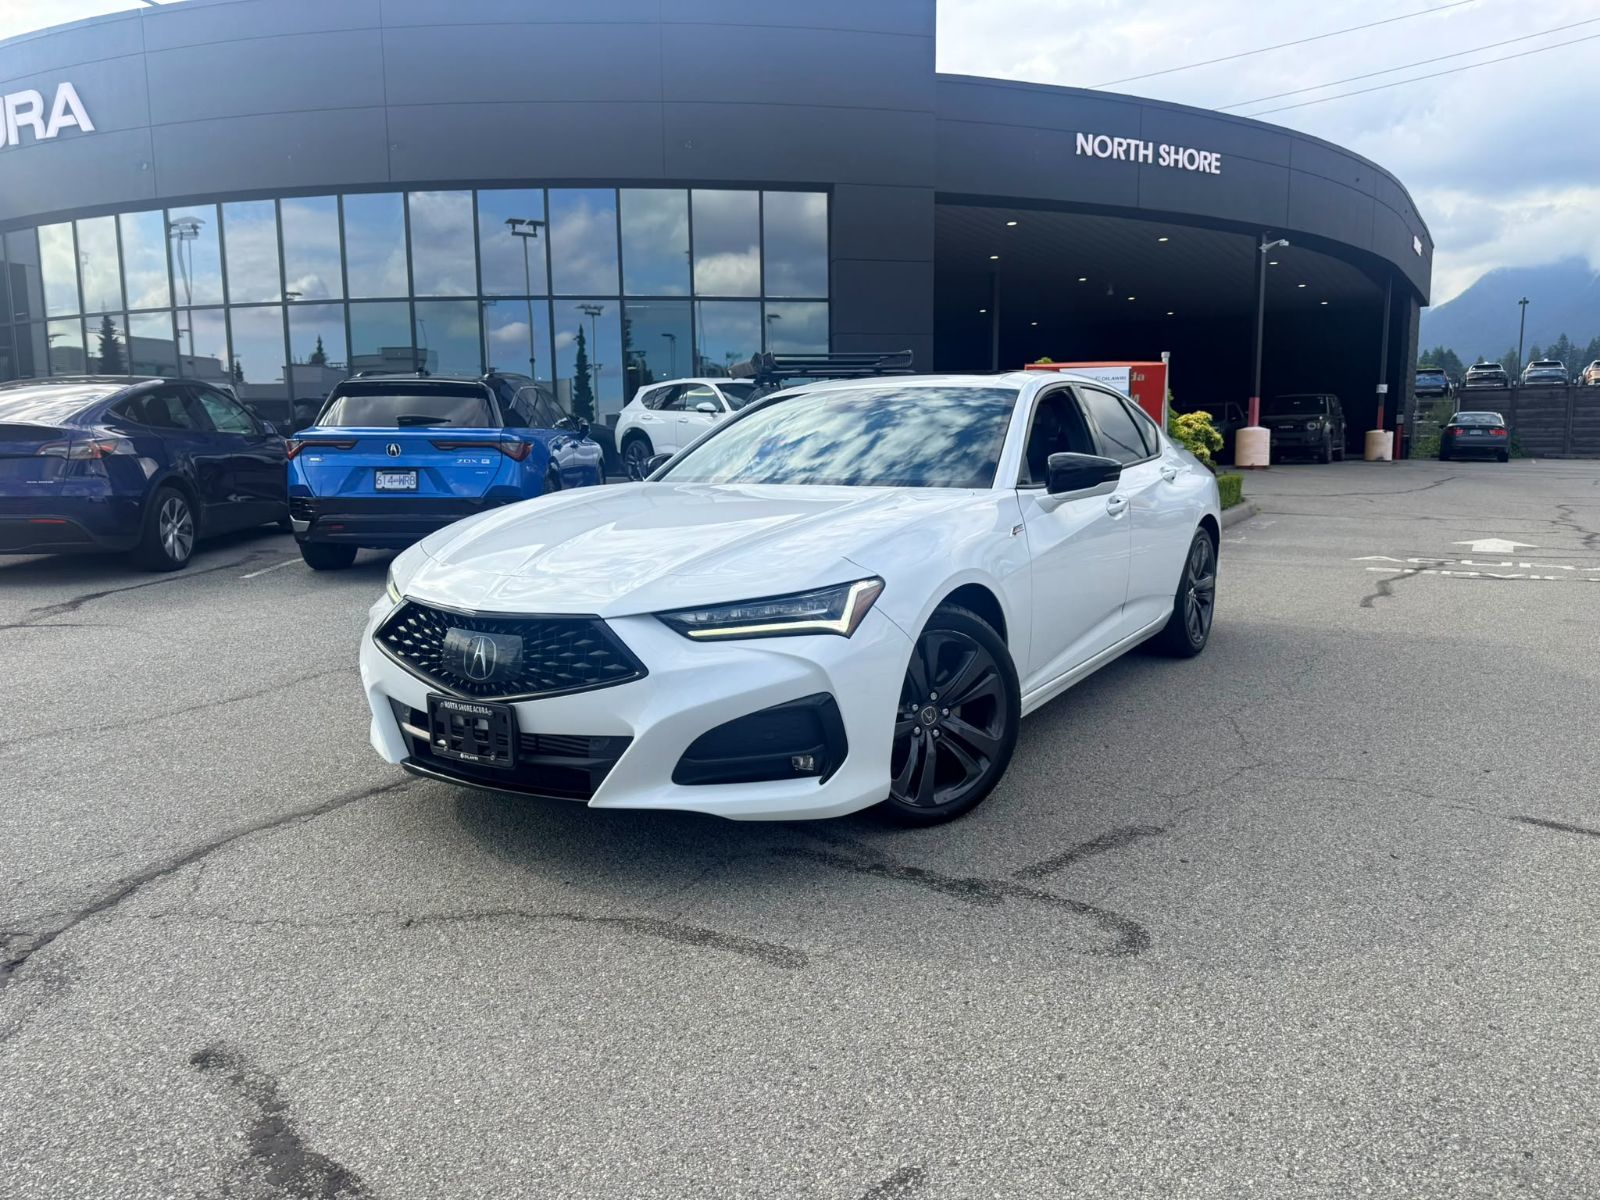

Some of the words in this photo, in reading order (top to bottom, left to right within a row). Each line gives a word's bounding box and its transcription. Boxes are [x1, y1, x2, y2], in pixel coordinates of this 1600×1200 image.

[1076, 132, 1154, 164] NORTH
[1158, 143, 1222, 175] SHORE
[444, 700, 458, 710] NORTH
[458, 703, 473, 713] SHORE
[473, 705, 489, 714] ACURA
